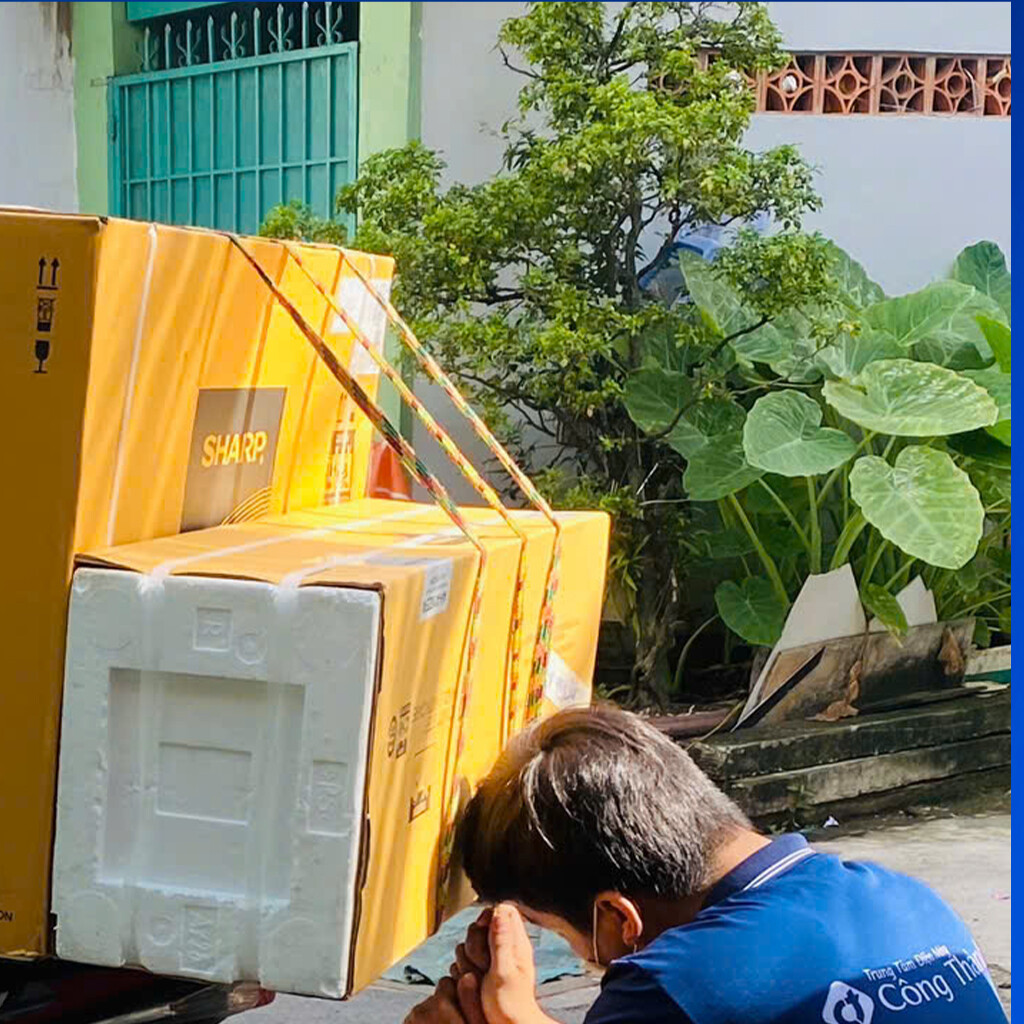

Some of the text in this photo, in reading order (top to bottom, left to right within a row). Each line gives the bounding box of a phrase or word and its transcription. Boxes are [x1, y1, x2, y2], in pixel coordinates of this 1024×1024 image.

[201, 431, 268, 468] SHARP
[862, 967, 897, 982] Trung
[894, 957, 918, 973] Tâm
[878, 973, 956, 1012] Công
